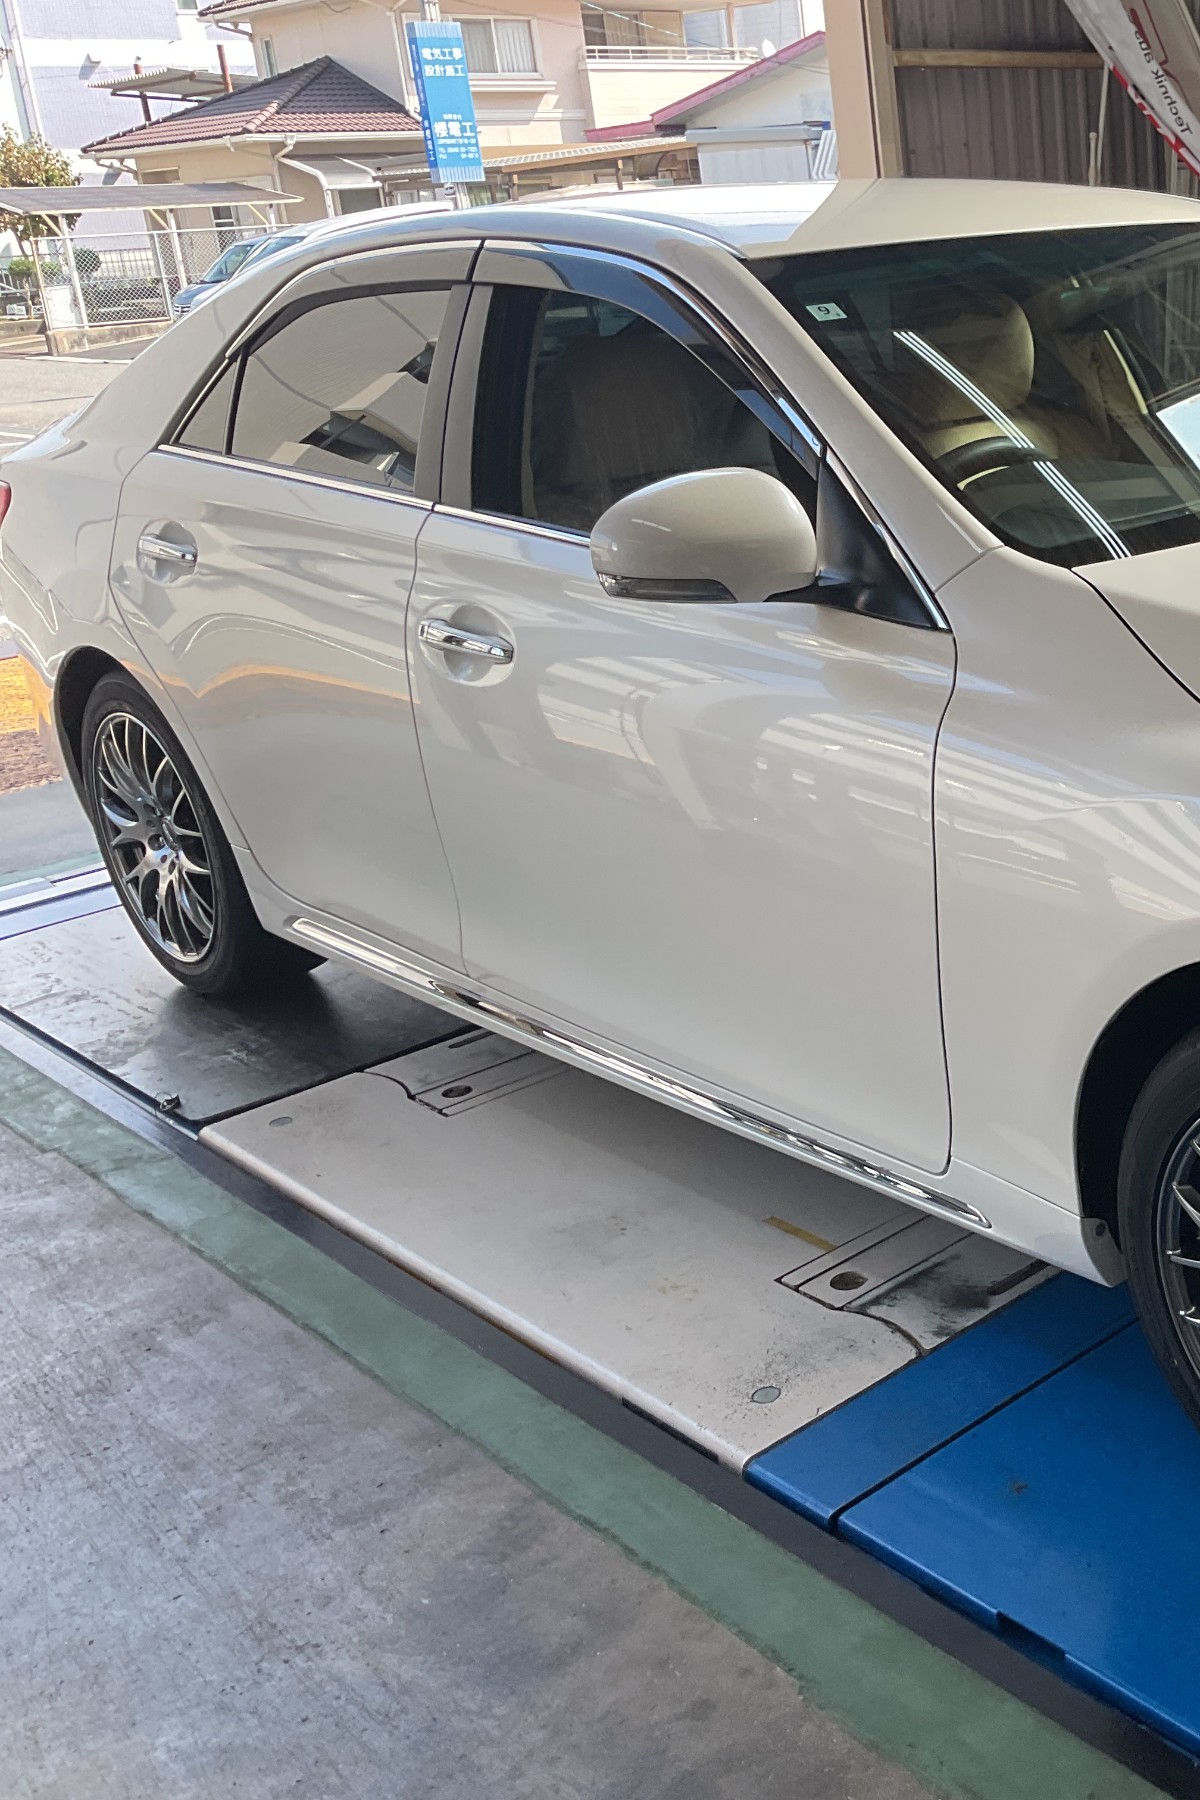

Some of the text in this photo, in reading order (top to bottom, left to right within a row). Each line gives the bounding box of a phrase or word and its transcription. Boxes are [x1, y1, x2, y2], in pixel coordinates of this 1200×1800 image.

[421, 47, 463, 60] 電気工事
[424, 64, 466, 77] 設計施工
[817, 306, 831, 315] 9
